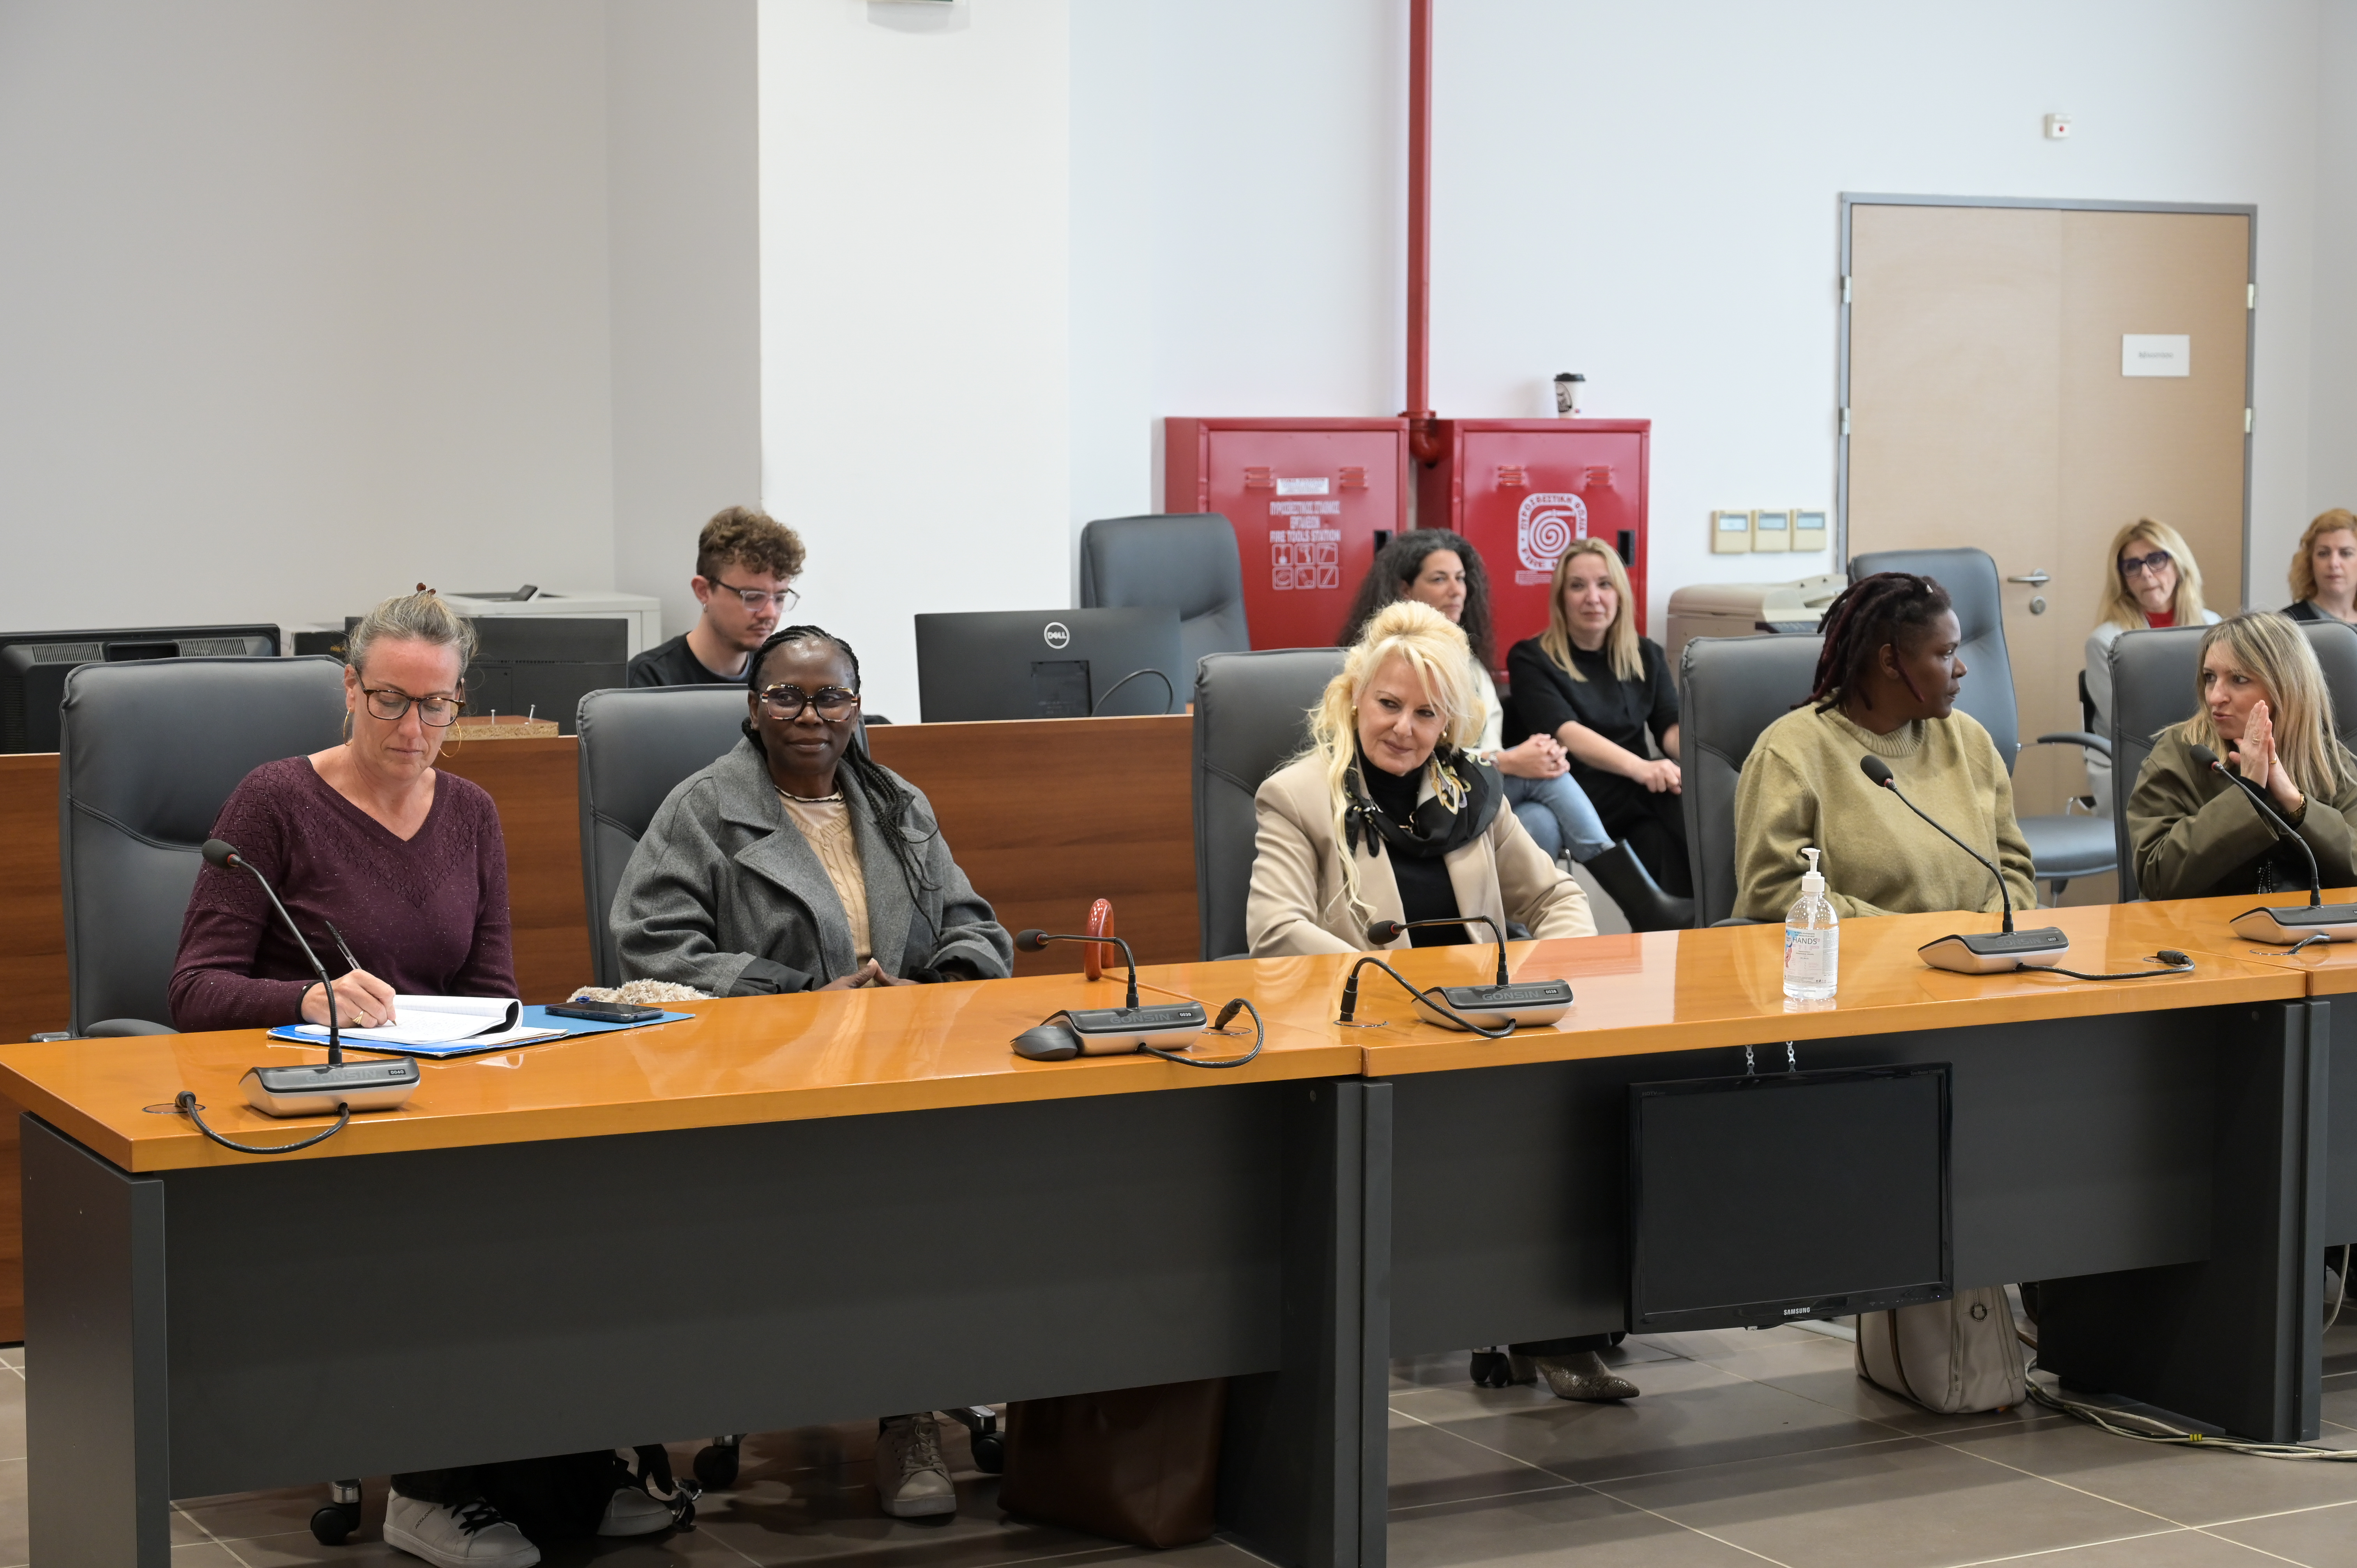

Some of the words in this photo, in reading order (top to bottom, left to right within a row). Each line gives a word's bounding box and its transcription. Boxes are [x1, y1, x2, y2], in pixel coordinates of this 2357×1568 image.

[1047, 631, 1067, 639] DELL
[1793, 936, 1817, 945] HANDS
[1996, 938, 2041, 946] GONSIN
[1482, 991, 1539, 1000] GONSIN
[1110, 1014, 1170, 1024] GONSIN
[306, 1070, 377, 1082] GONSIN
[1784, 1307, 1810, 1315] SAMSUNG
